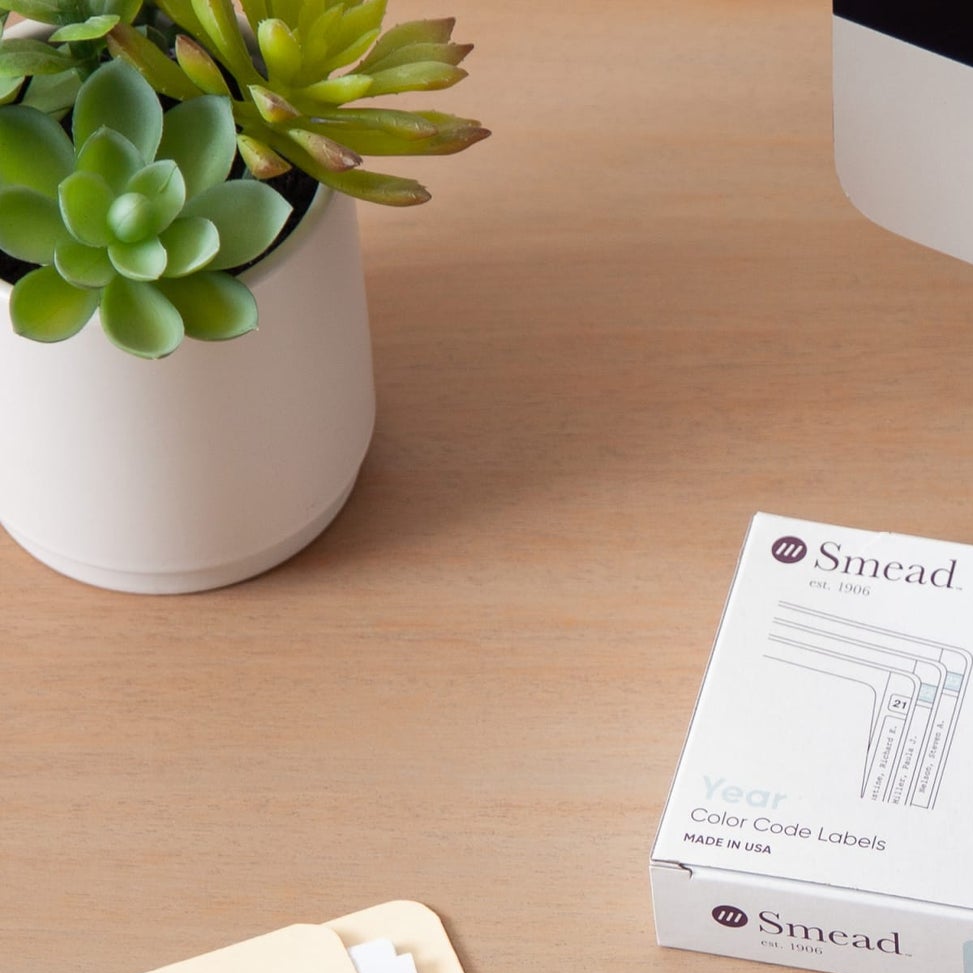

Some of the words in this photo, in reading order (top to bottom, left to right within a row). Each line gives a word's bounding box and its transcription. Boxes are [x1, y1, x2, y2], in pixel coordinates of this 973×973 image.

[814, 540, 958, 590] Smead
[809, 579, 831, 591] est.
[838, 581, 871, 597] 1906
[892, 699, 907, 710] 21
[703, 775, 788, 810] Year
[683, 832, 724, 848] MADE
[727, 839, 741, 850] IN
[744, 841, 772, 855] USA
[690, 807, 748, 829] Color
[753, 817, 812, 839] Code
[817, 826, 887, 851] Labels
[758, 910, 902, 955] Smead
[761, 939, 783, 949] est.
[790, 942, 823, 955] 1906
